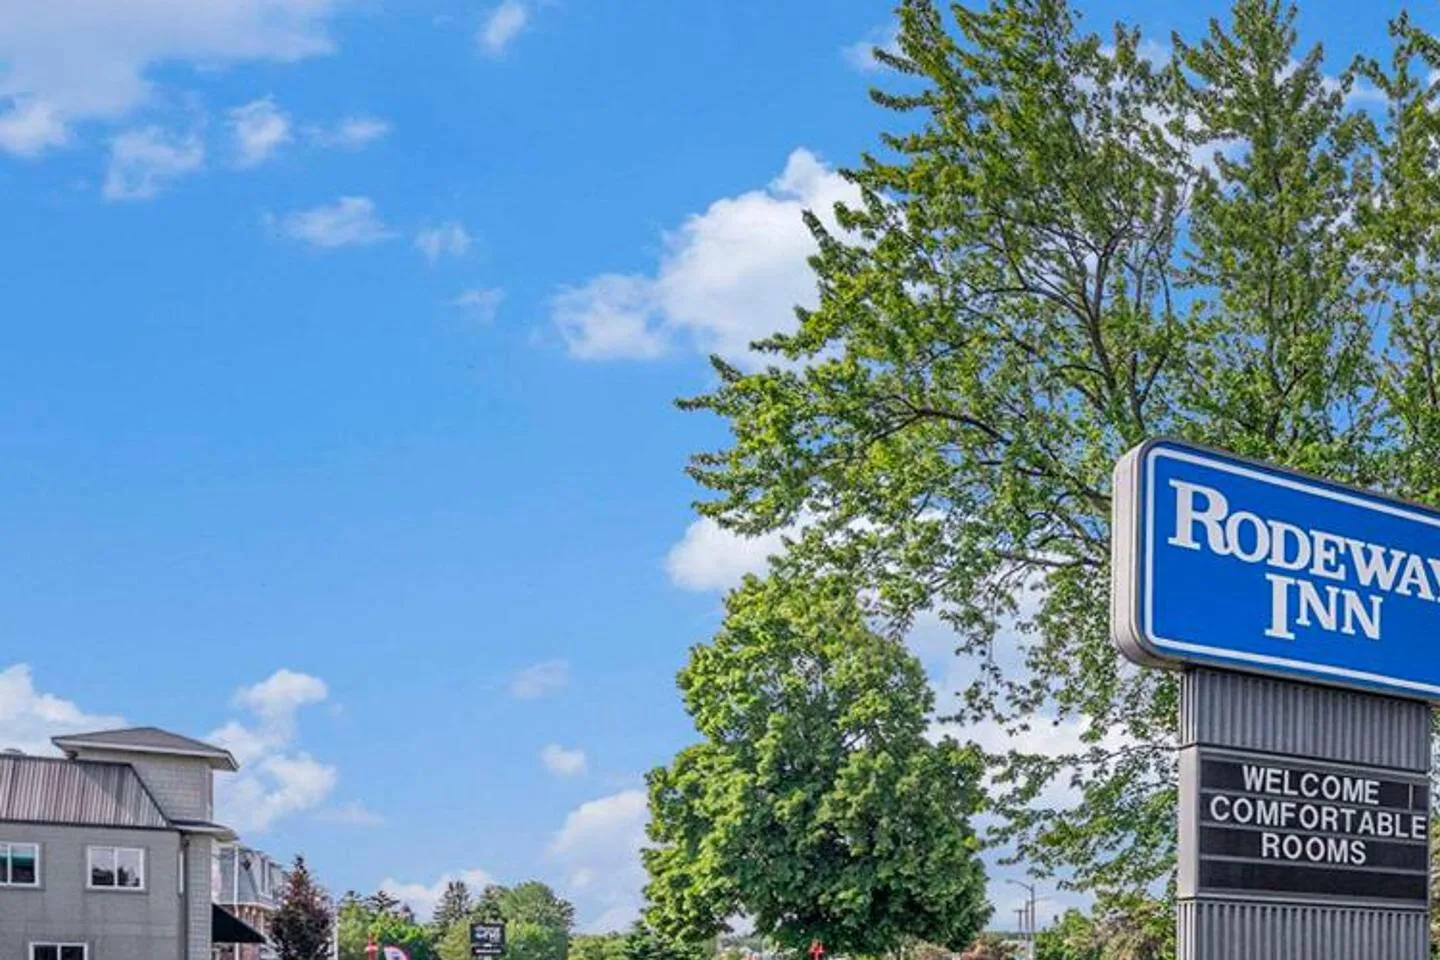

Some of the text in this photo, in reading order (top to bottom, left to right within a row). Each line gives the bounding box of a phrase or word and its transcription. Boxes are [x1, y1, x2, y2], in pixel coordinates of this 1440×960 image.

[1265, 573, 1383, 640] INN
[1242, 765, 1380, 804] WELCOME
[1210, 797, 1426, 840] COMFORTABLE
[1262, 833, 1366, 865] ROOMS
